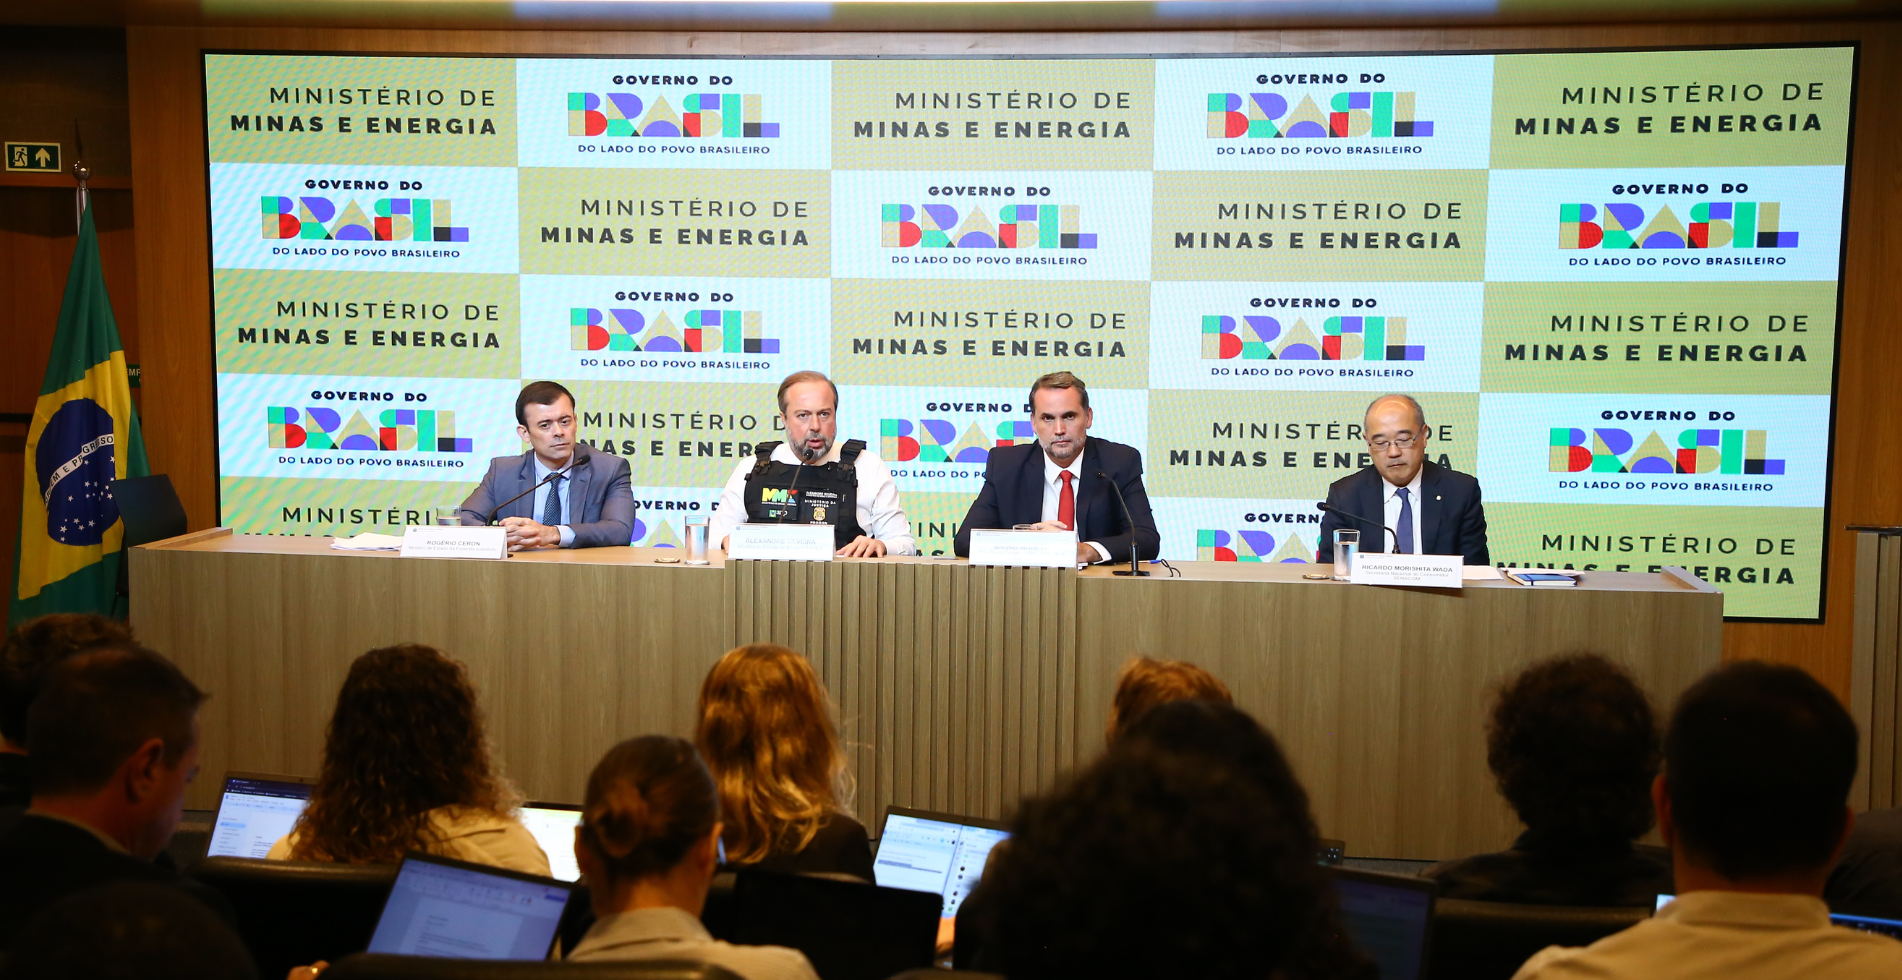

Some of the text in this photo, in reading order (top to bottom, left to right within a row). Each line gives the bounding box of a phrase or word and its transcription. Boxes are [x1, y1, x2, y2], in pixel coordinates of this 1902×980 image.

[613, 76, 732, 85] GOVERNO DO
[1257, 74, 1385, 84] GOVERNO DO
[270, 86, 494, 106] MINISTÉRIO DE
[896, 90, 1129, 109] MINISTÉRIO DE
[1563, 82, 1823, 104] MINISTÉRIO DE
[568, 92, 780, 138] BRASIL
[1207, 91, 1434, 138] BRASIL
[231, 115, 495, 134] MINAS E ENERGIA
[855, 122, 1130, 138] MINAS E ENERGIA
[1515, 113, 1821, 135] MINAS E ENERGIA
[1347, 146, 1422, 154] BRASILEIRO
[305, 180, 422, 190] GOVERNO DO
[929, 187, 1050, 196] GOVERNO DO
[1613, 184, 1748, 194] GOVERNO DO
[582, 200, 807, 217] MINISTÉRIO DE
[1219, 200, 1461, 219] MINISTÉRIO DE
[261, 195, 469, 241] BRASIL
[882, 204, 1097, 249] BRASIL
[1558, 202, 1799, 249] BRASIL
[542, 227, 808, 245] MINAS E ENERGIA
[1175, 232, 1460, 248] MINAS E ENERGIA
[1707, 257, 1786, 265] BRASILEIRO
[615, 292, 733, 302] GOVERNO DO
[1250, 298, 1376, 307] GOVERNO DO
[277, 300, 498, 321] MINISTÉRIO DE
[895, 309, 1125, 329] MINISTÉRIO DE
[570, 308, 780, 354] BRASIL
[1552, 312, 1808, 332] MINISTÉRIO DE
[238, 328, 499, 348] MINAS E ENERGIA
[1202, 315, 1425, 361] BRASIL
[854, 339, 1125, 357] MINAS E ENERGIA
[1505, 344, 1807, 362] MINAS E ENERGIA
[701, 361, 770, 369] BRASILEIRO
[311, 391, 426, 401] GOVERNO DO
[926, 403, 1012, 412] GOVERNO
[1602, 411, 1735, 421] GOVERNO DO
[266, 406, 472, 451] BRASIL
[584, 411, 757, 430] MINISTÉRIO
[1213, 421, 1363, 440] MINISTÉR
[651, 441, 664, 455] E
[679, 441, 754, 457] ENER
[1548, 427, 1785, 475] BRASIL
[360, 458, 391, 466] POVO
[397, 459, 463, 468] BRASILEIRO
[1170, 450, 1267, 466] MINAS
[1284, 452, 1297, 467] E
[1695, 483, 1773, 491] BRASILEIRO
[283, 507, 430, 525] MINISTÉRI
[1244, 513, 1319, 523] GOVERN
[1542, 533, 1796, 555] MINISTÉRIO DE
